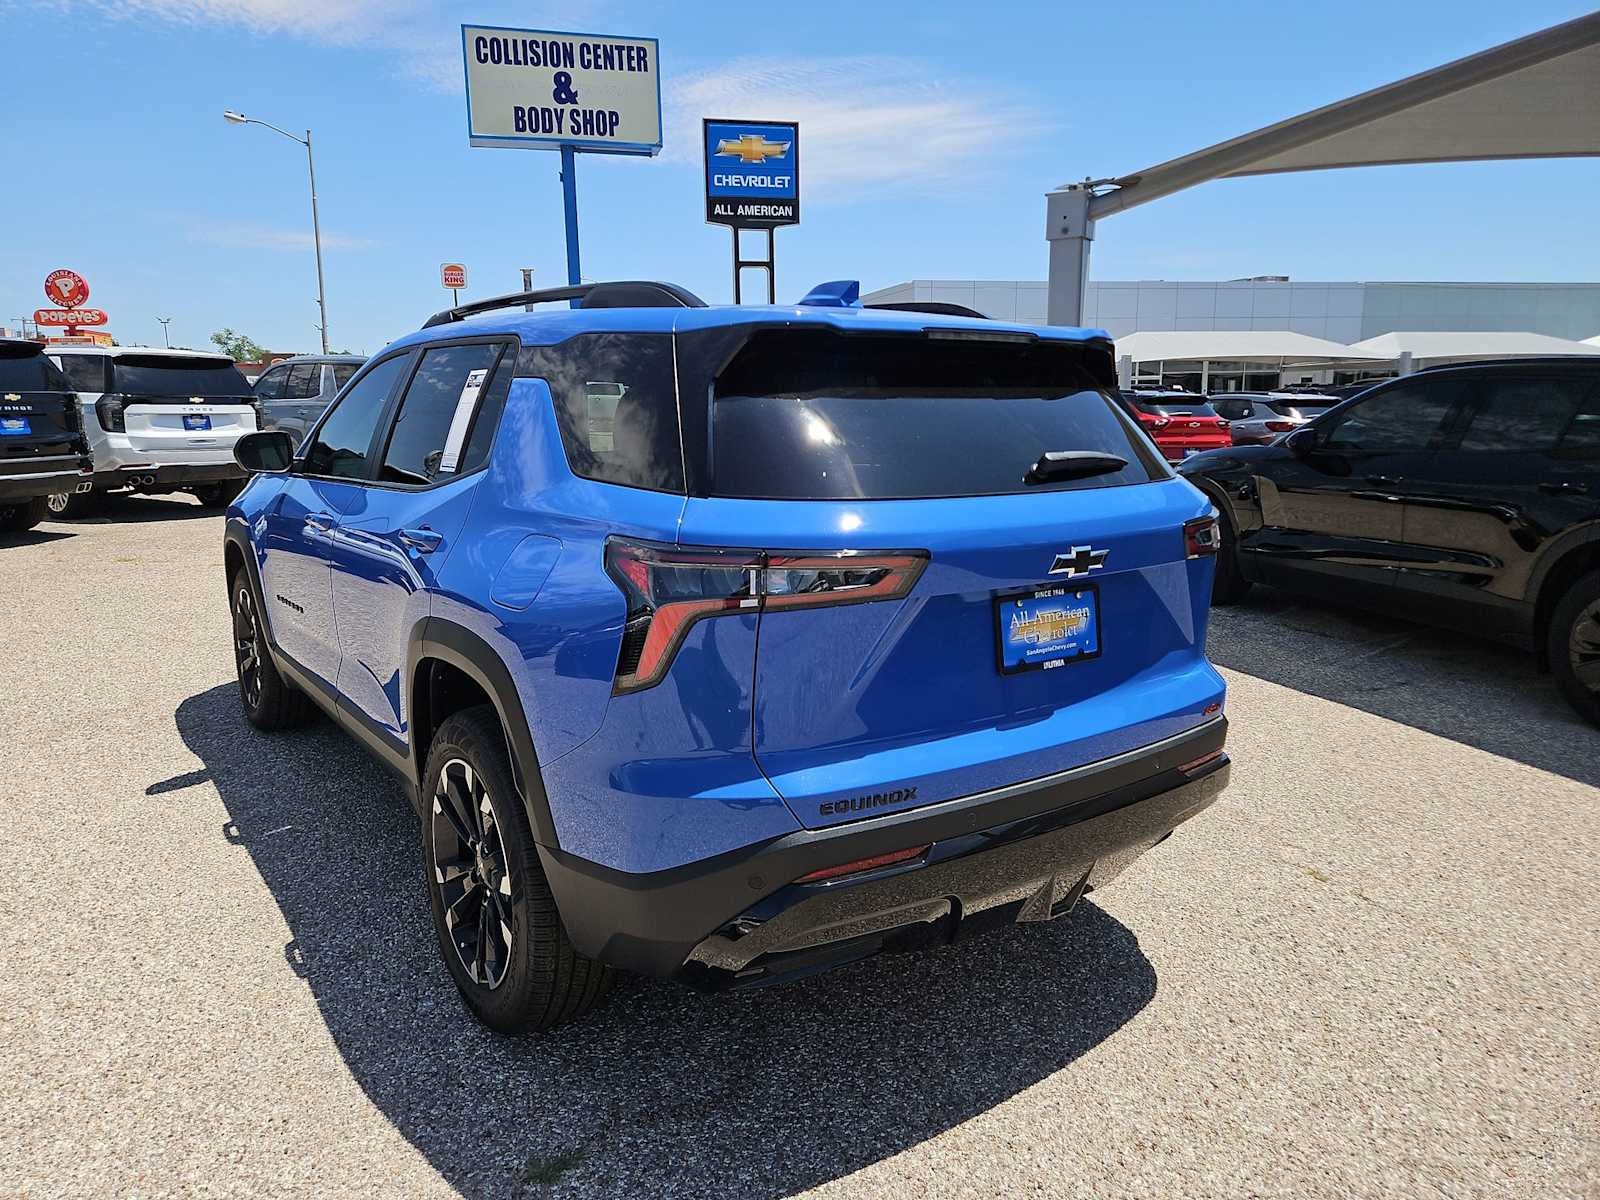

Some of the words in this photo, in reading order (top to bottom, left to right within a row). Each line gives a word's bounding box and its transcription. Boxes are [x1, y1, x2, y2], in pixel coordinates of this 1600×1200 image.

[474, 35, 574, 69] COLLISION
[579, 42, 648, 72] CENTER
[552, 71, 579, 105] &
[513, 105, 565, 135] BODY
[569, 108, 620, 137] SHOP
[714, 174, 791, 189] CHEVROLET
[714, 204, 734, 216] ALL
[737, 205, 793, 217] AMERICAN
[46, 270, 83, 287] LOUISIANA
[54, 278, 76, 298] P
[48, 294, 83, 307] KITCHEN
[1034, 590, 1051, 599] SINCE
[1010, 610, 1029, 629] All
[1034, 605, 1090, 625] American
[1026, 642, 1077, 656] SanAngeloChevy.com
[819, 786, 919, 816] EQUINOX
